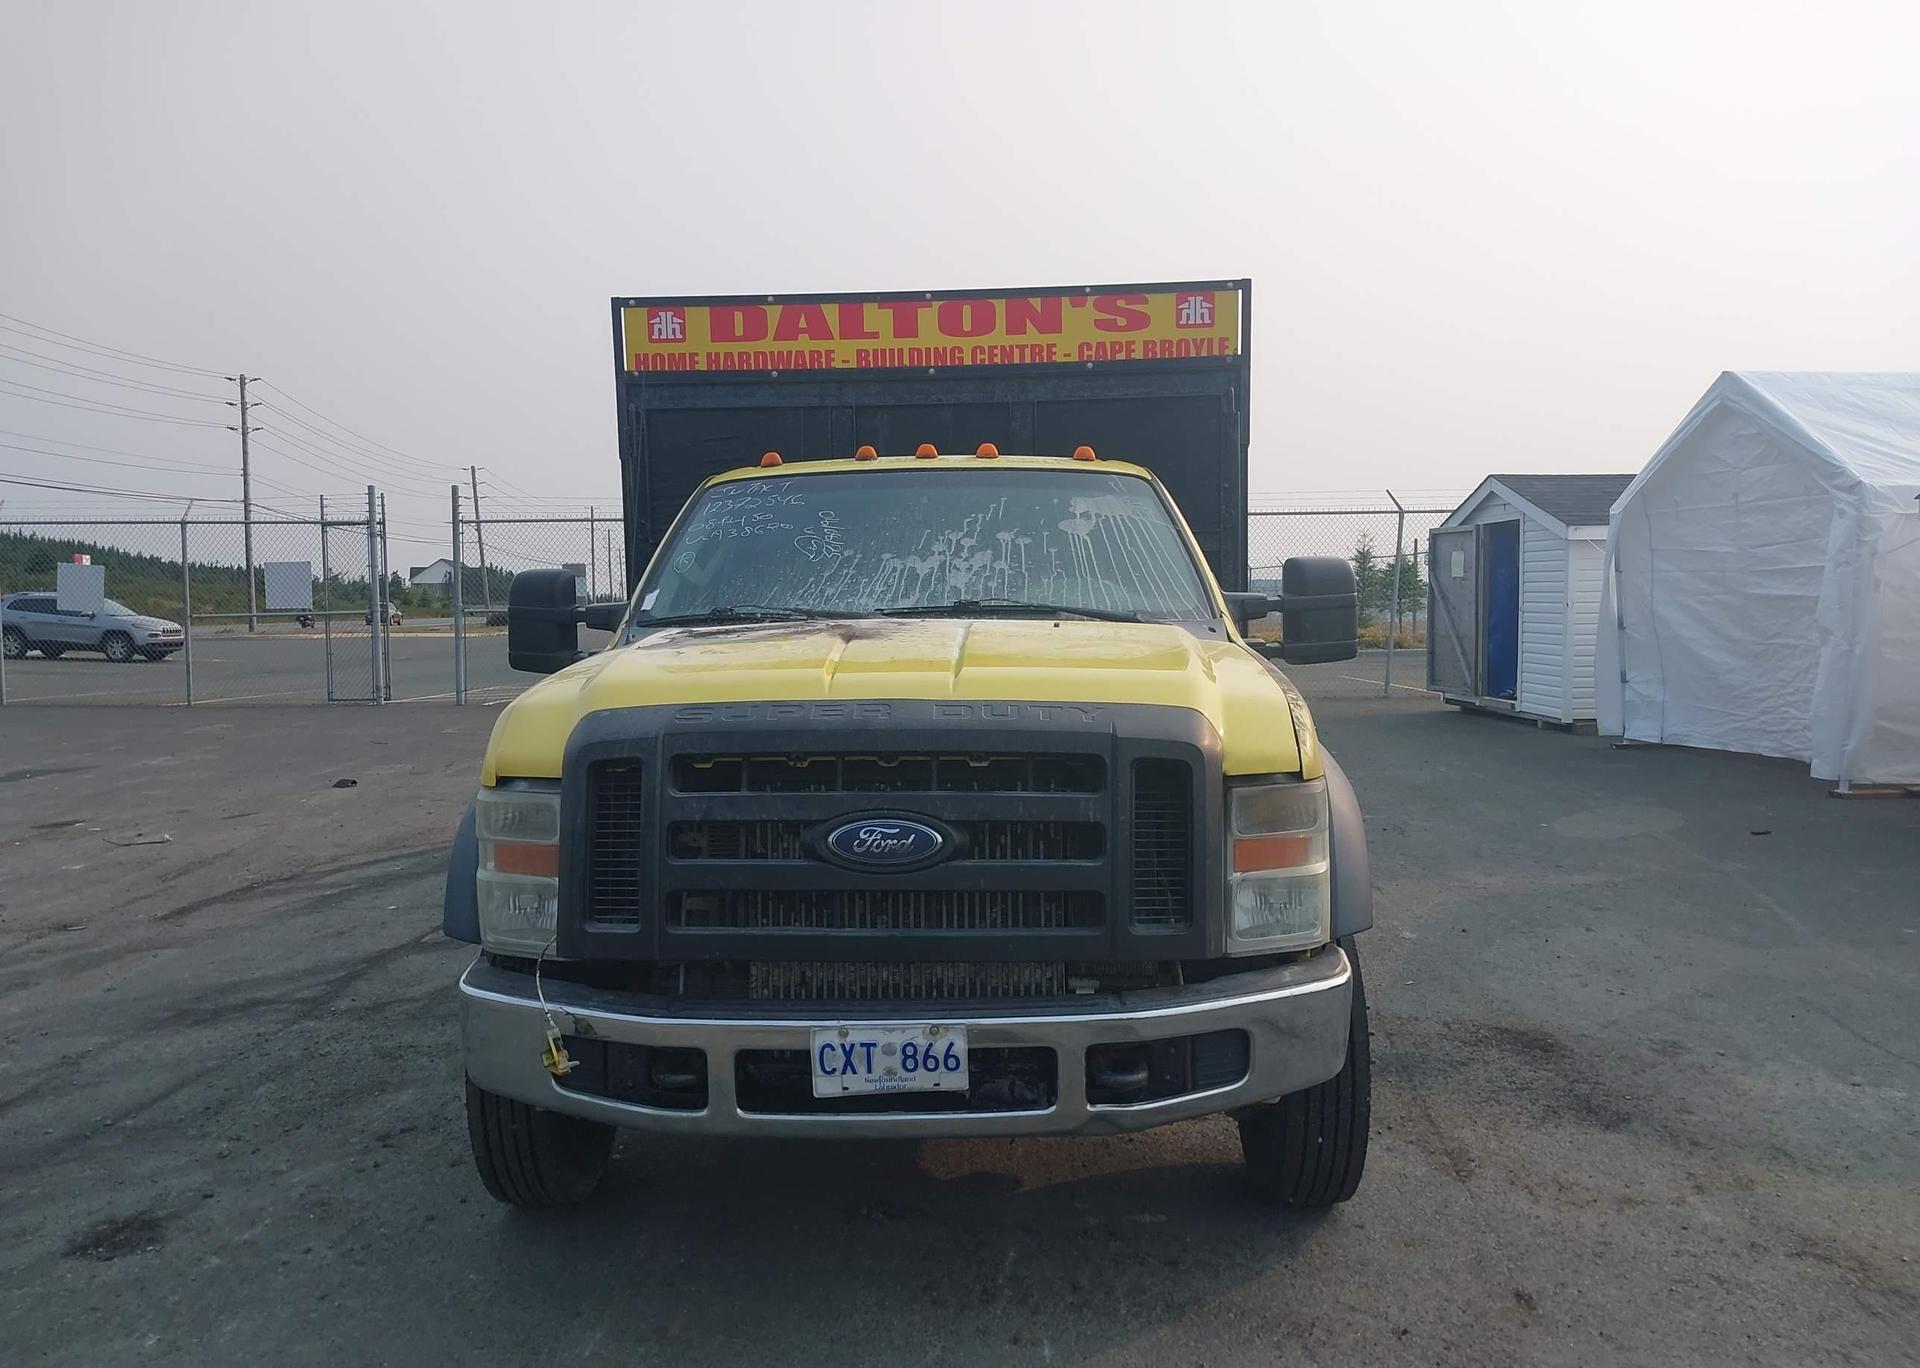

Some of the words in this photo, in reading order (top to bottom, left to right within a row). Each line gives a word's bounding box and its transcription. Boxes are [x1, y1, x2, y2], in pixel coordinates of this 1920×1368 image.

[709, 291, 1151, 342] DALTON'S
[635, 351, 699, 371] HOME
[706, 349, 835, 370] HARDWARE
[856, 345, 964, 369] BUILDING
[971, 343, 1056, 366] CENTRE
[1078, 340, 1136, 361] CAPE
[1143, 337, 1230, 360] BROYLE
[674, 703, 892, 724] SUPER
[933, 704, 1104, 722] DUTY
[853, 827, 915, 853] Ford
[819, 1042, 877, 1075] CXT
[902, 1041, 961, 1073] 866
